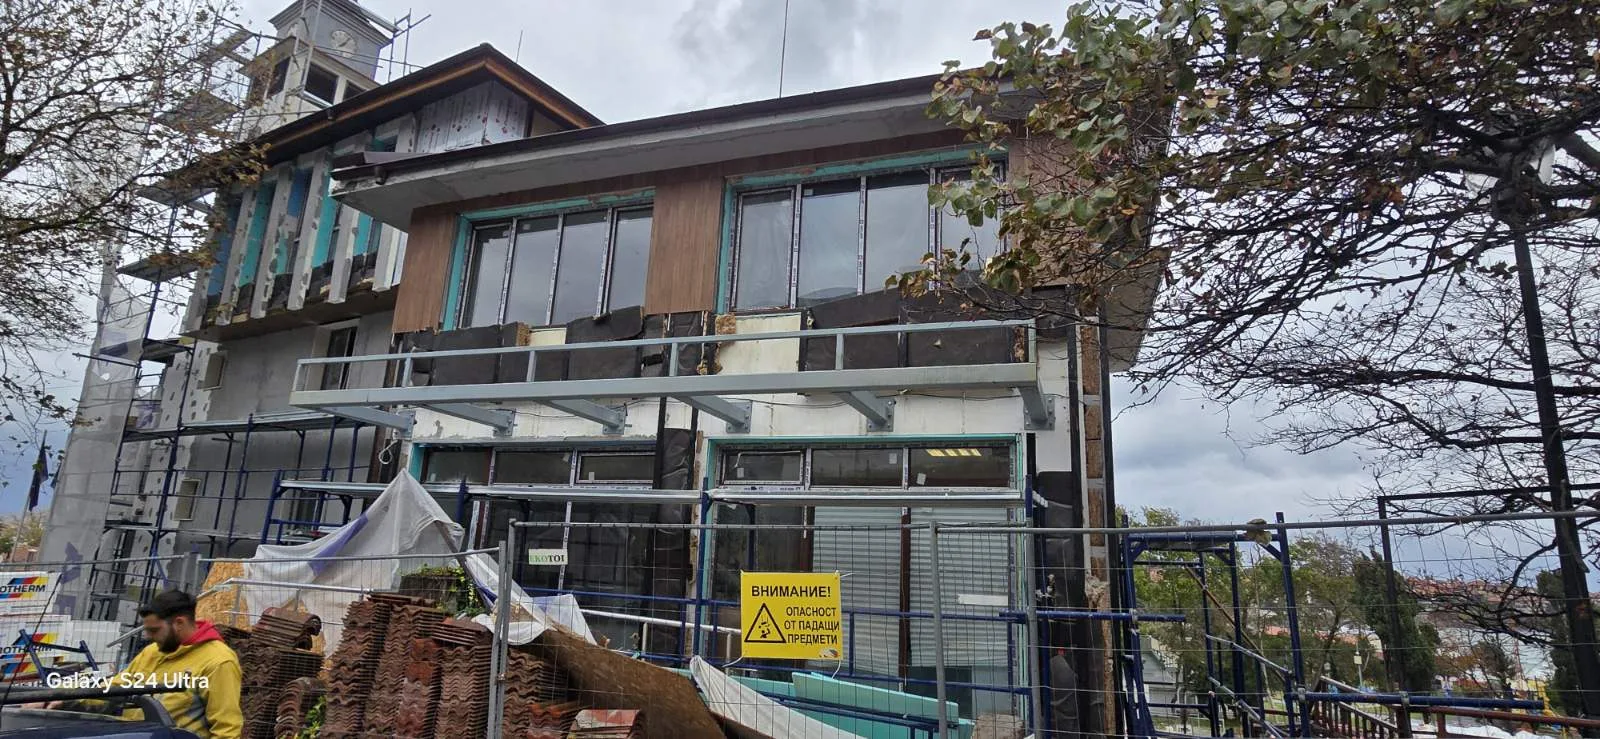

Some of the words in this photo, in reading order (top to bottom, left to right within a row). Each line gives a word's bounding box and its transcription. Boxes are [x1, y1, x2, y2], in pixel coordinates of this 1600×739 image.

[751, 585, 831, 597] ВНИМАНИЕ!
[786, 606, 836, 617] ОПАСНОСТ
[784, 620, 796, 630] ОТ
[798, 620, 840, 632] ПАДАЩИ
[787, 634, 838, 645] ПРЕДМЕТИ
